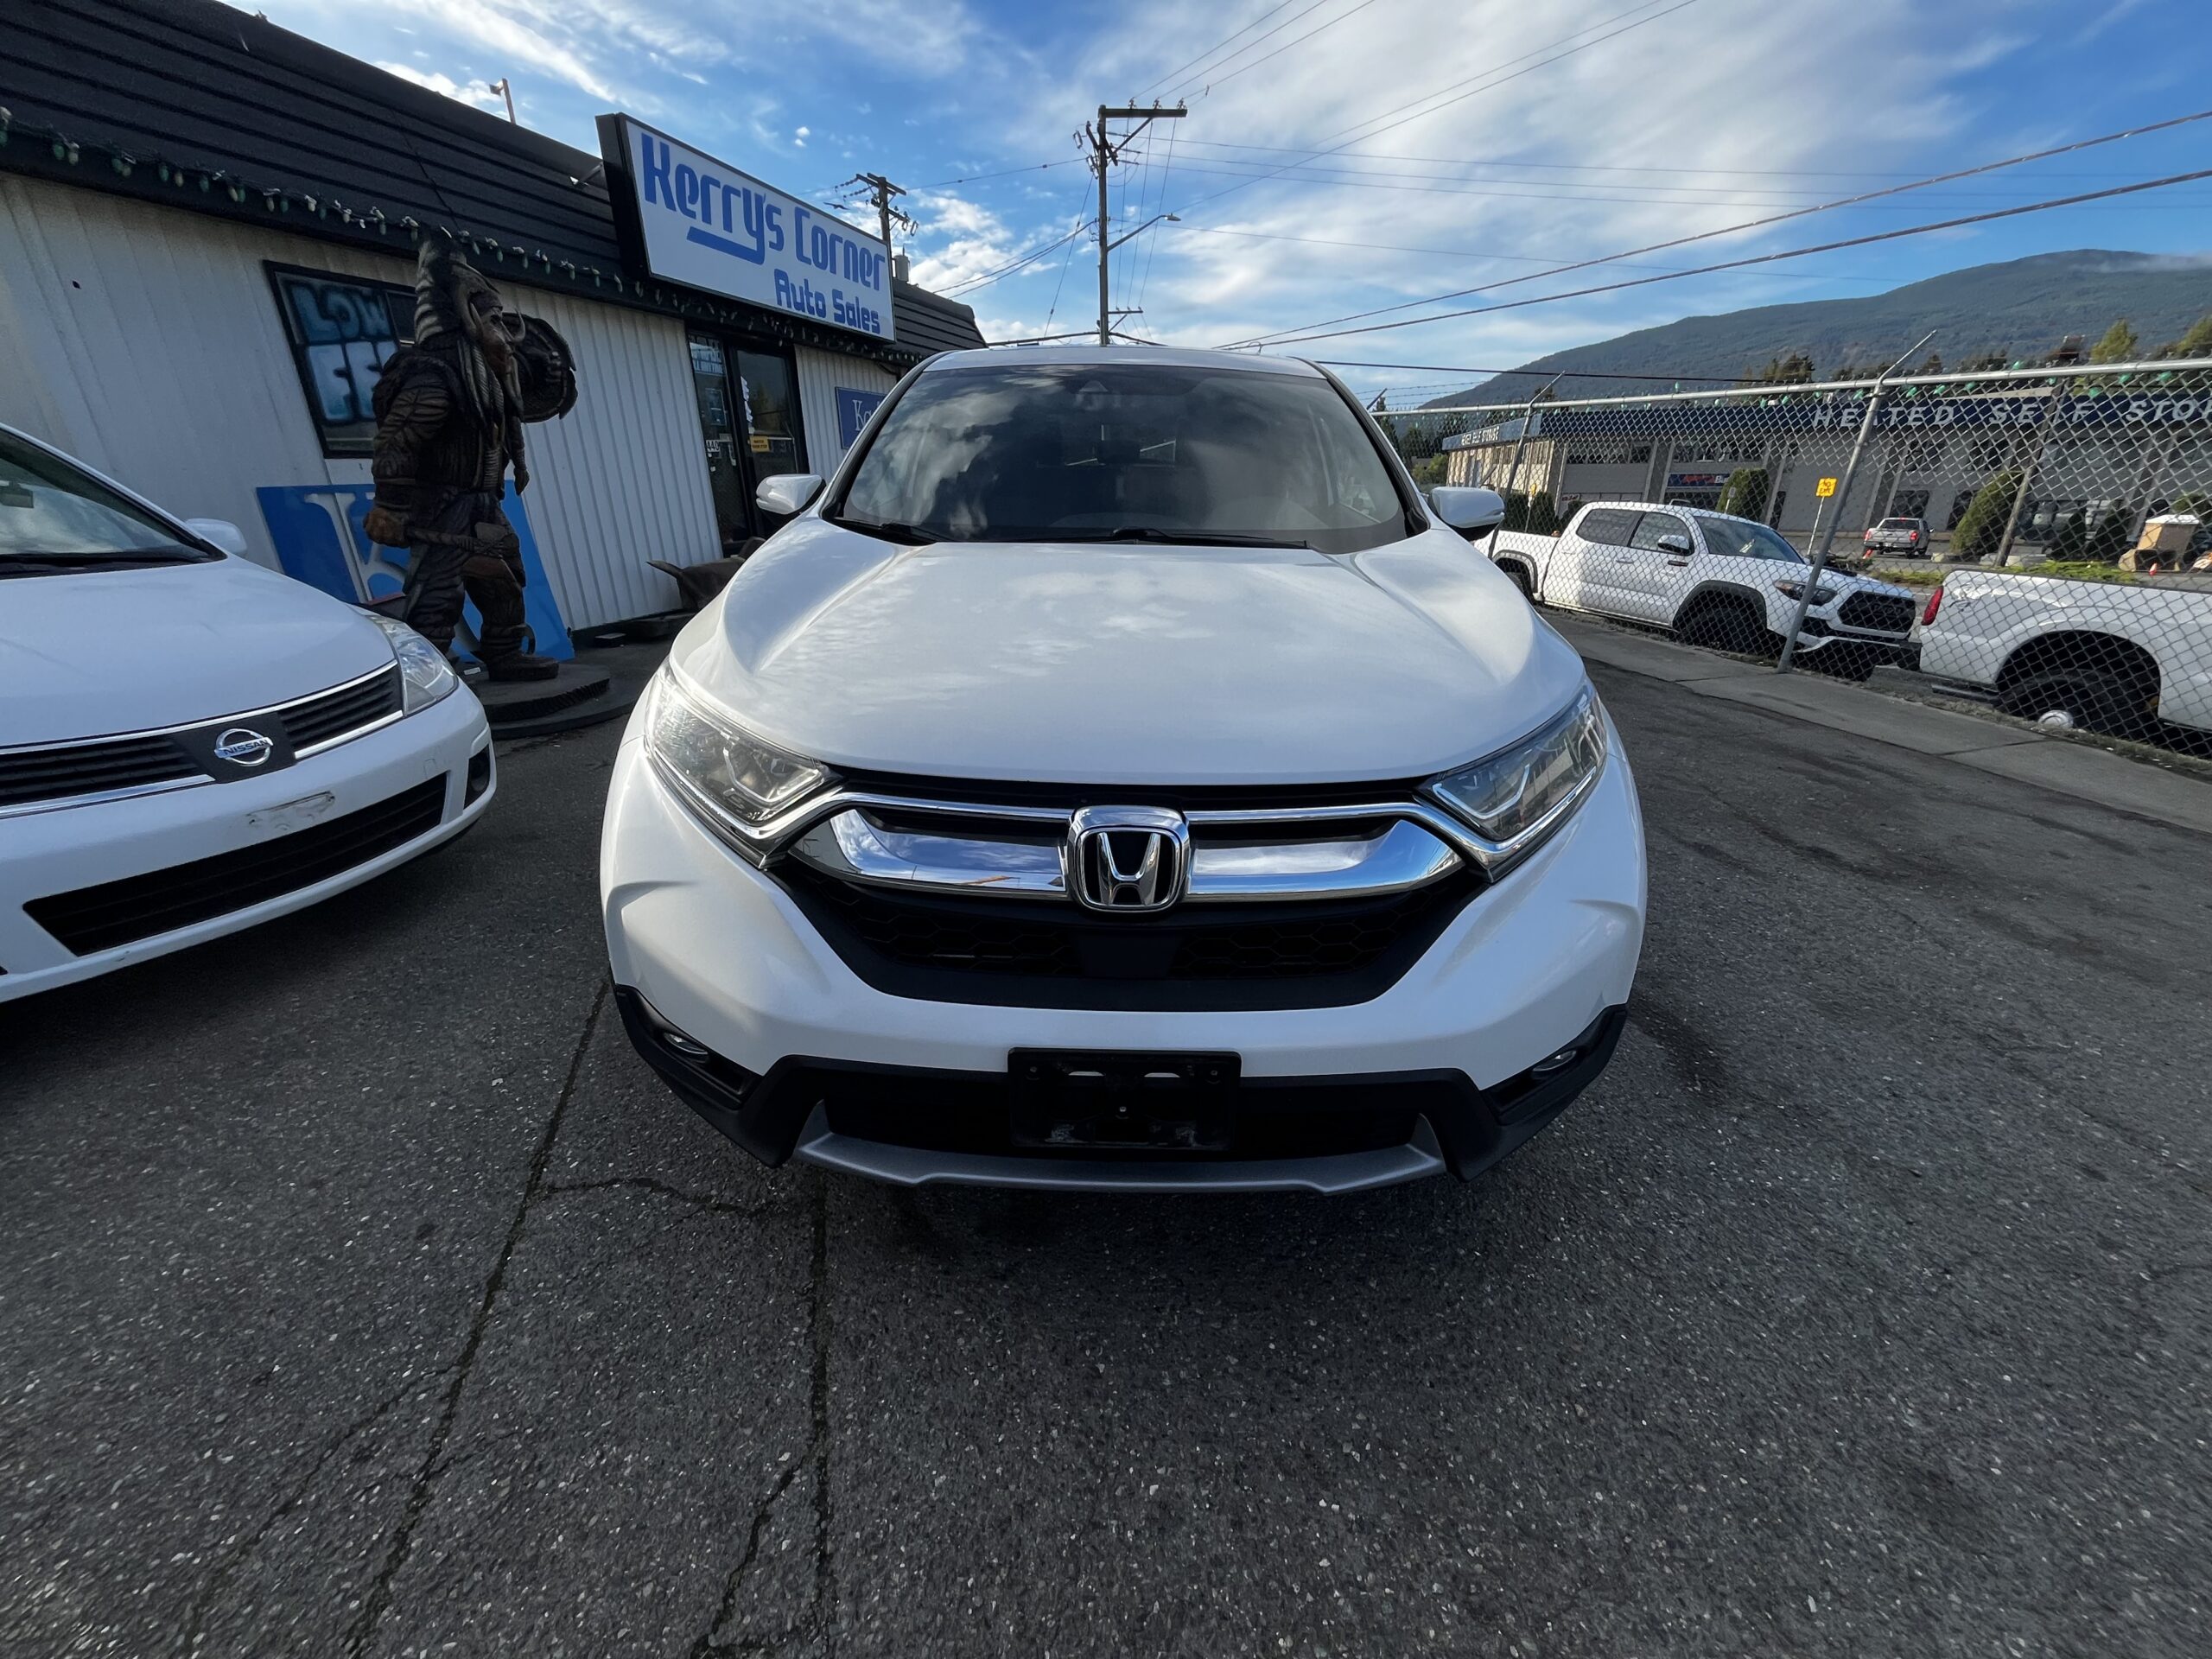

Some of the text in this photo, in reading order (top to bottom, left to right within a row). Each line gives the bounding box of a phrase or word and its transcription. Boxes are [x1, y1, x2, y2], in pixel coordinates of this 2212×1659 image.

[794, 207, 886, 291] Corner
[774, 268, 881, 334] Auto Sales
[1814, 405, 1955, 427] HETED
[223, 738, 269, 756] NISSAN
